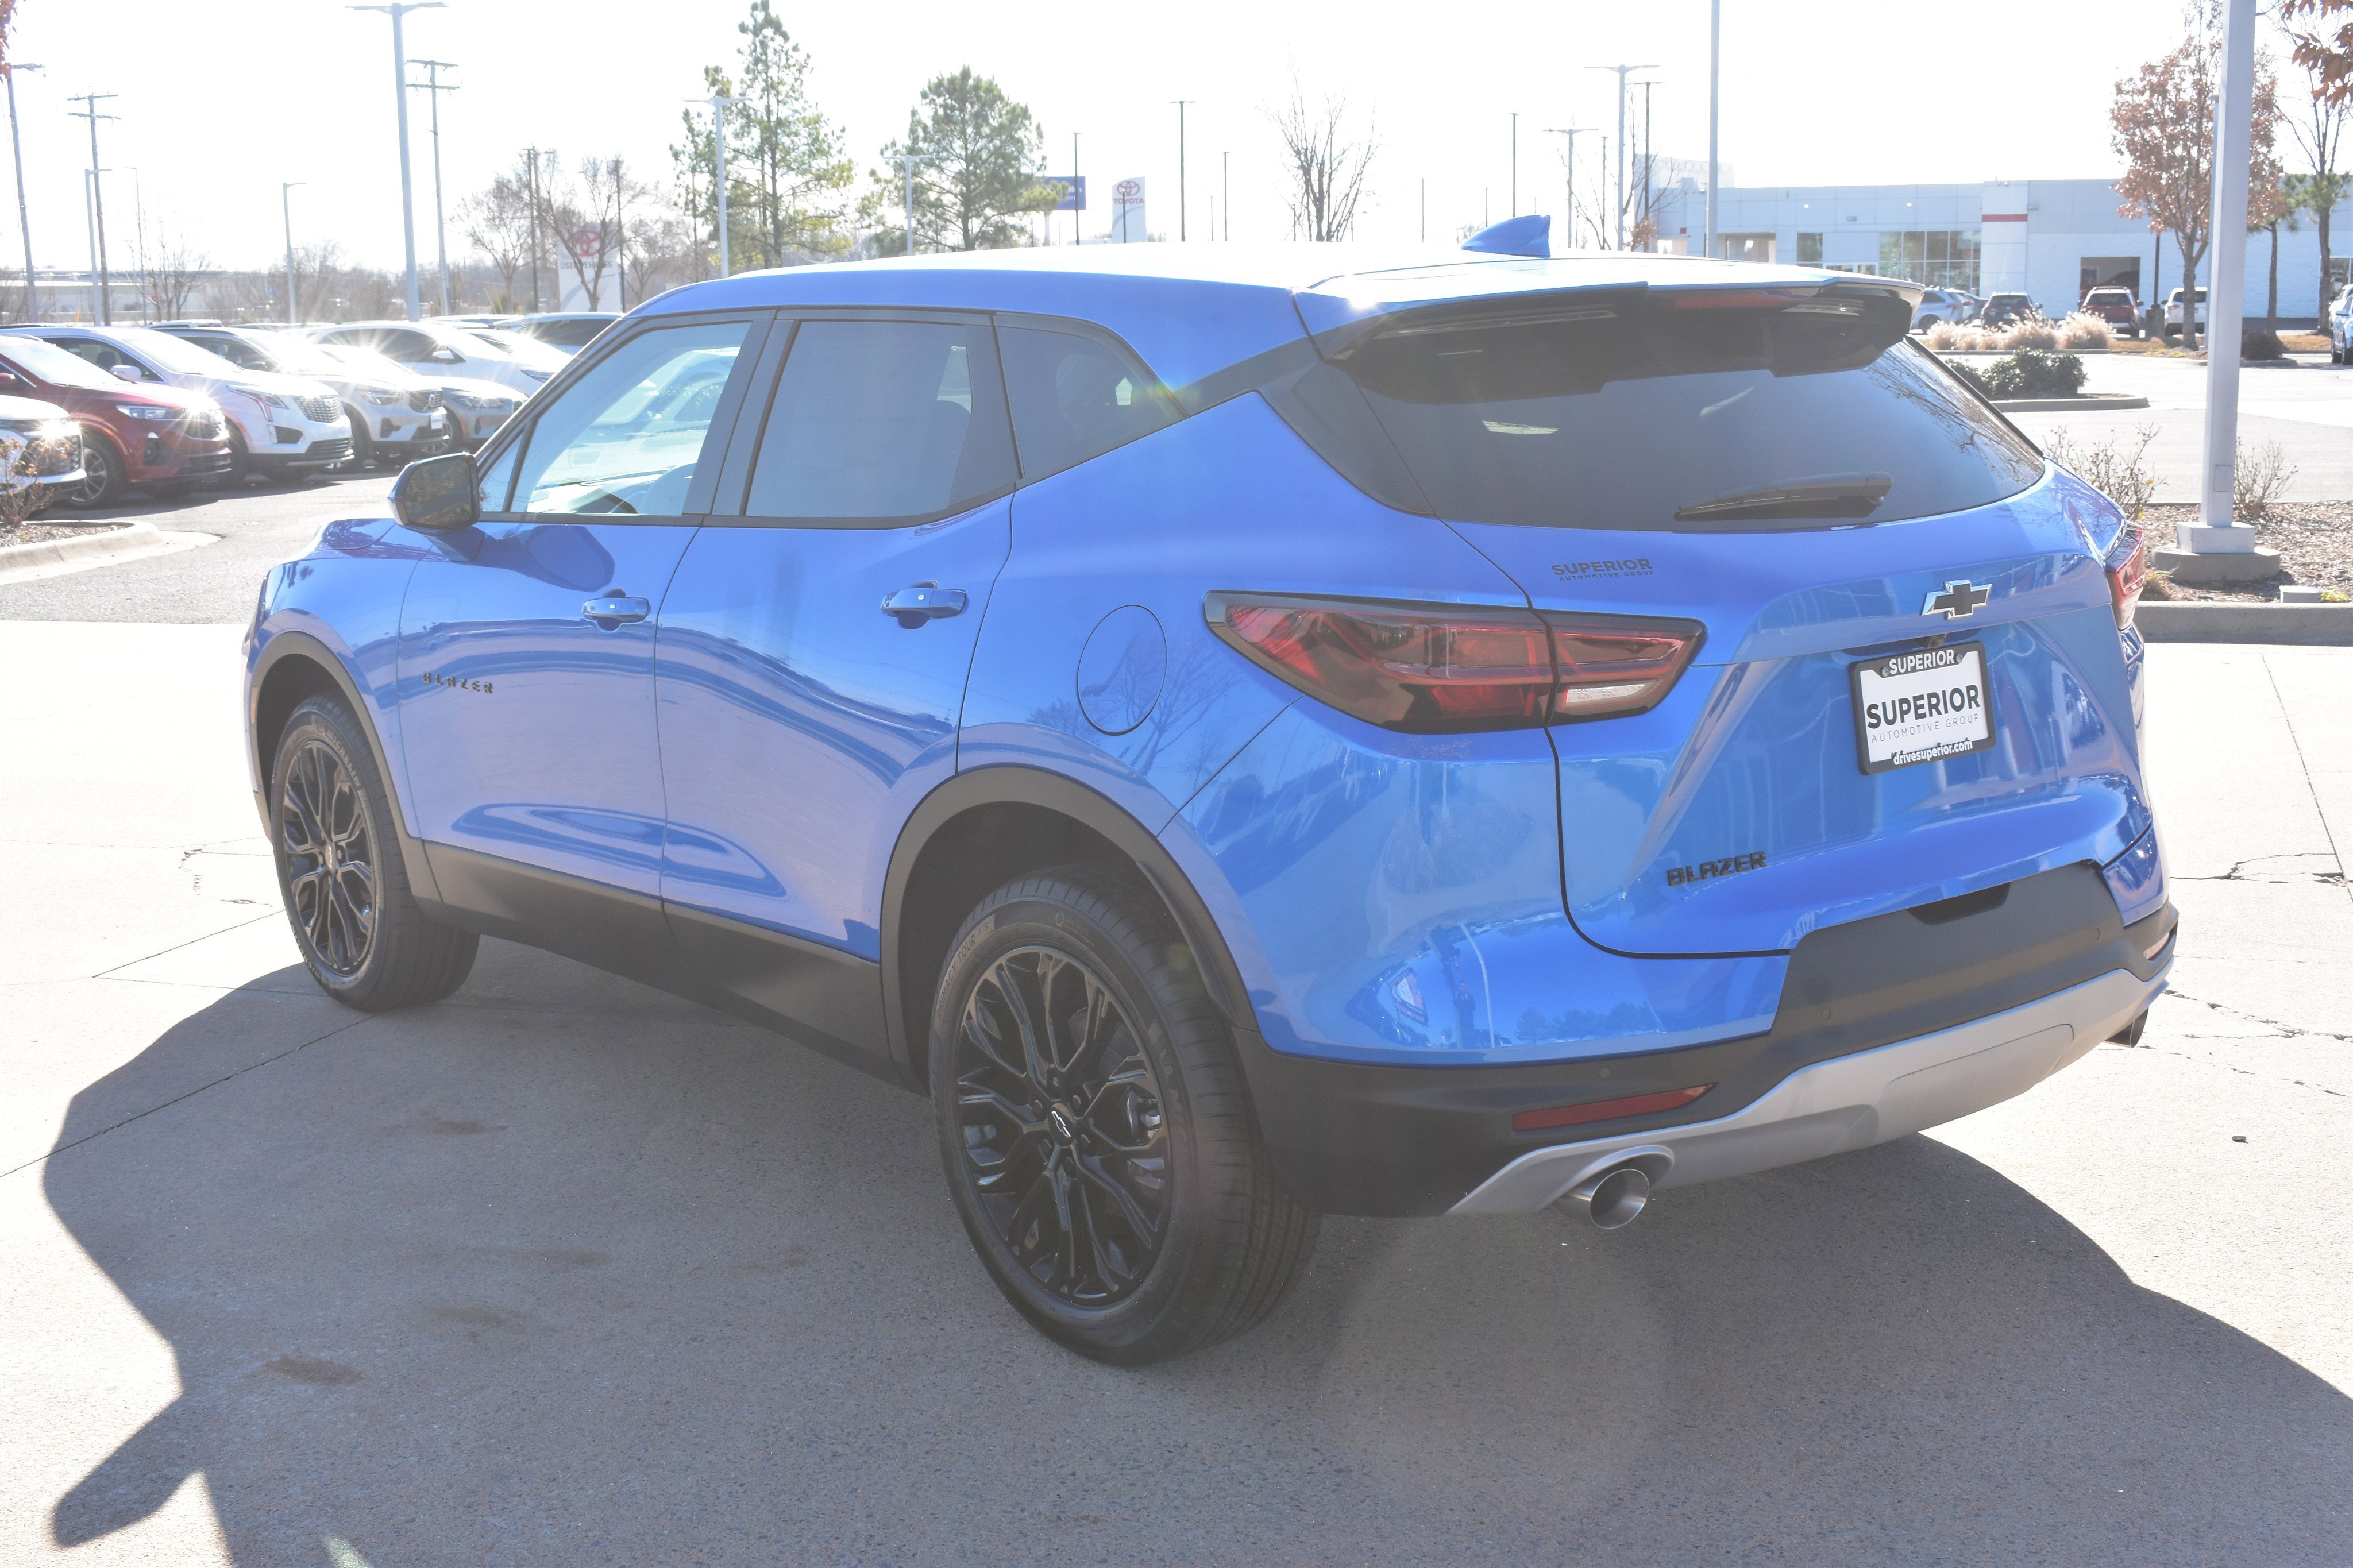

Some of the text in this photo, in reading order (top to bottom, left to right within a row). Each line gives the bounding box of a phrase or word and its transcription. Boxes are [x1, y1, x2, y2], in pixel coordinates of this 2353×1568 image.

[1552, 558, 1653, 576] SUPERIOR
[1560, 572, 1620, 581] AUTOMOTIVE
[1889, 648, 1955, 675] SUPERIOR
[422, 671, 493, 694] BLAZER
[1866, 684, 1980, 729] SUPERIOR
[1871, 713, 1979, 743] AUTOMOTIVE GROUP
[326, 731, 361, 787] MICHELIN
[1893, 739, 1973, 766] drivesuperior.com
[1667, 851, 1768, 887] BLAZER
[936, 964, 957, 1018] PRIMACY
[958, 934, 977, 964] TOUR
